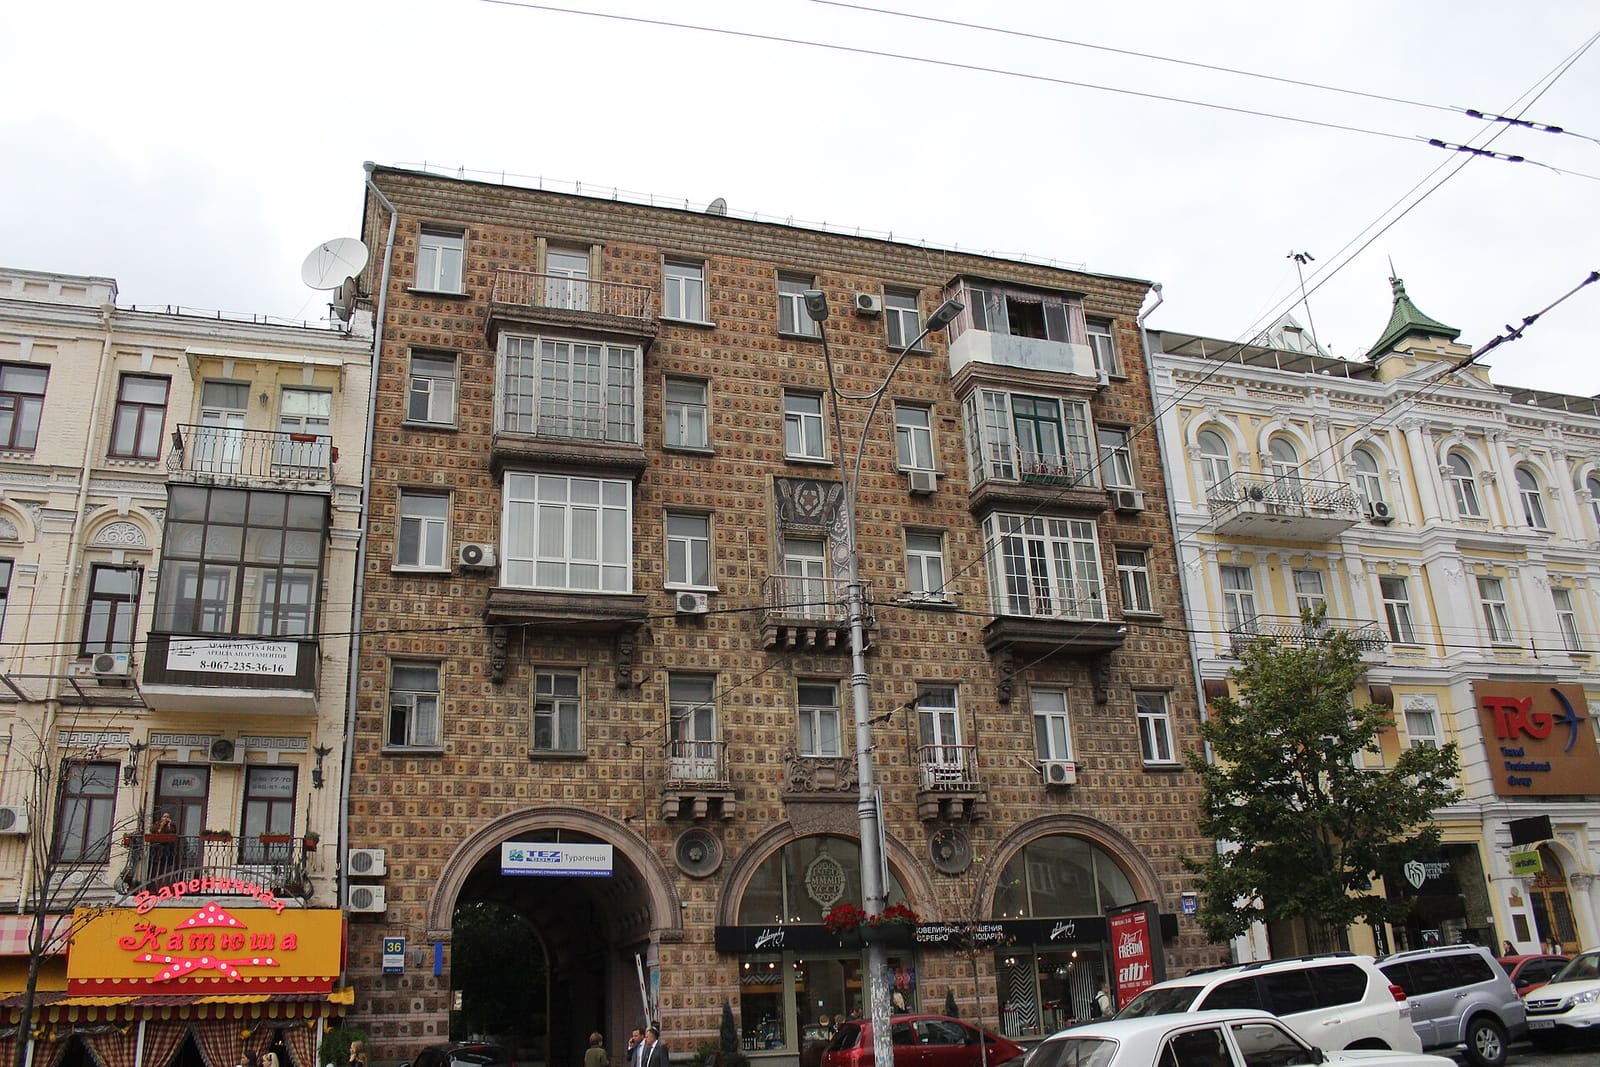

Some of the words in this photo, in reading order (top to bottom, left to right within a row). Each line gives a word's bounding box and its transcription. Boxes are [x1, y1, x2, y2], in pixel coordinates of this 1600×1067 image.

[200, 660, 284, 673] 8-067-235-36-16
[1481, 696, 1553, 740] TPG
[526, 850, 561, 858] TEZ
[564, 853, 606, 863] Турагенція
[133, 876, 286, 915] Вареничная
[119, 922, 297, 951] Катюша
[387, 942, 402, 952] 36
